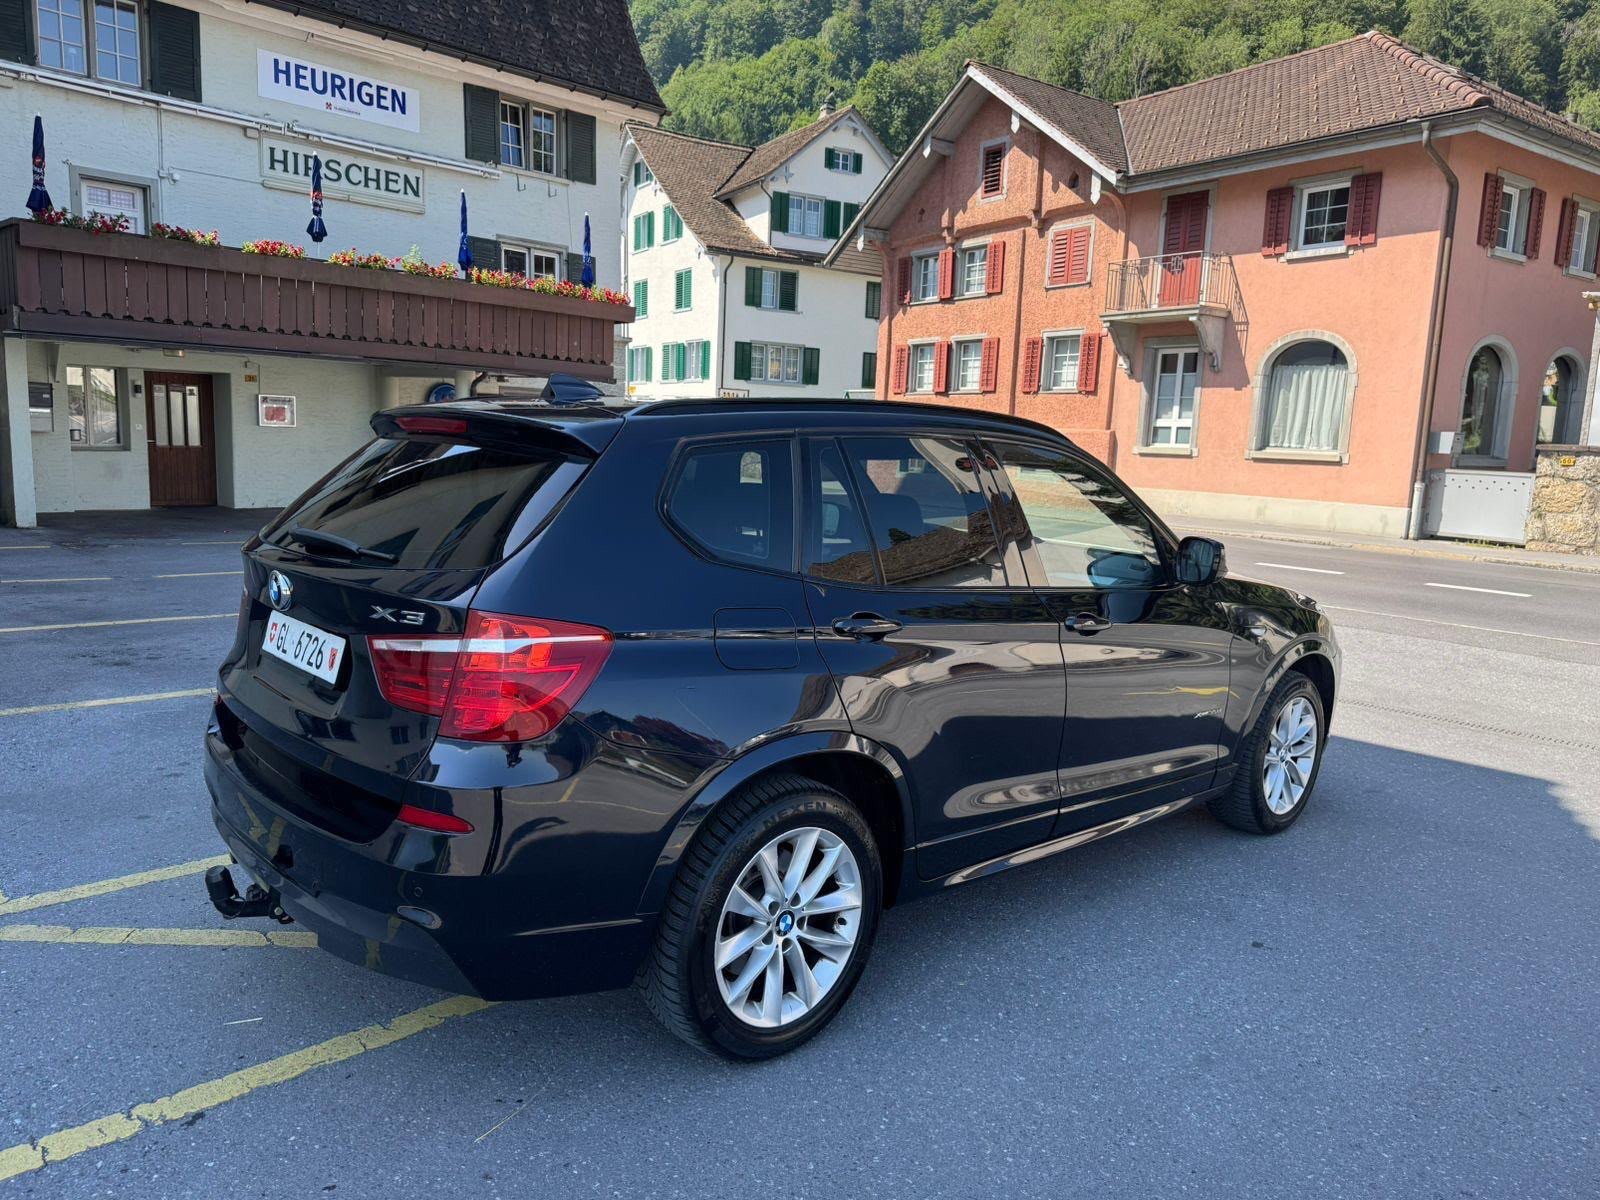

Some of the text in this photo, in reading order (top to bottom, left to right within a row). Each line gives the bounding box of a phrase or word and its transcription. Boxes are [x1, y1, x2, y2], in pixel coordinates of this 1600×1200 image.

[273, 58, 406, 115] HEURIGEN
[369, 604, 425, 625] X3
[276, 622, 326, 670] GL 6726
